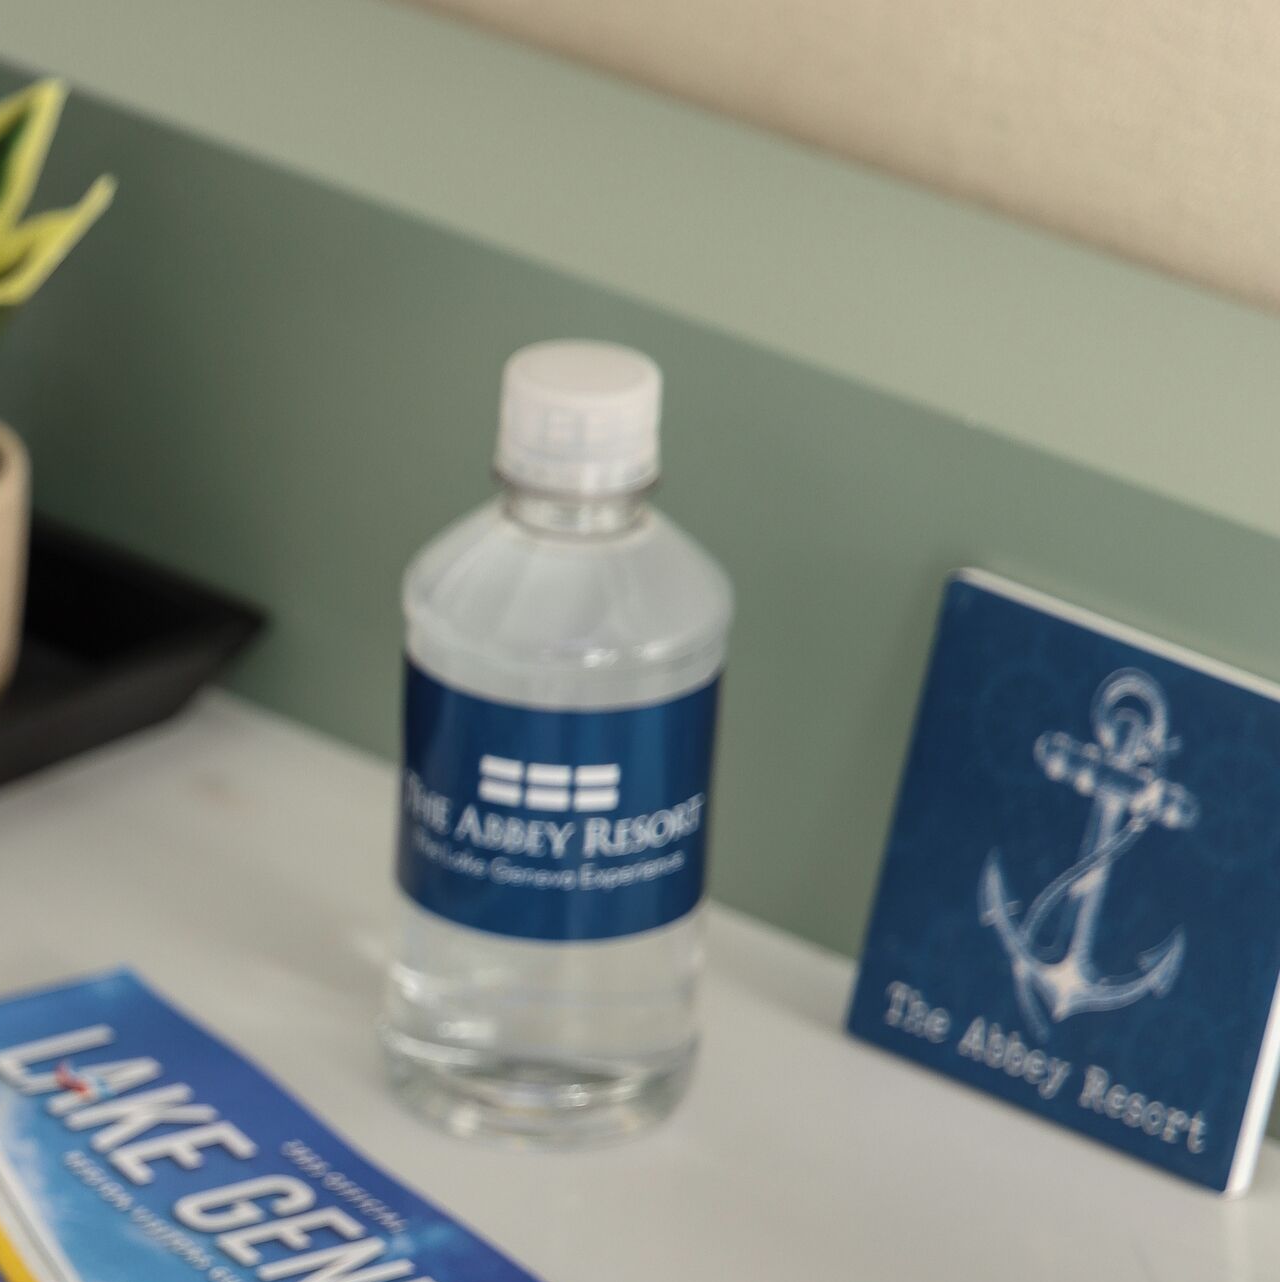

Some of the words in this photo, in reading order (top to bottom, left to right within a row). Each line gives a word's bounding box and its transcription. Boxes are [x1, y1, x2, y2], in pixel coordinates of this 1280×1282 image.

[454, 804, 575, 858] ABBEY
[583, 792, 705, 858] RESORT
[885, 980, 951, 1043] The
[957, 1016, 1072, 1099] Abbey
[1077, 1065, 1207, 1153] Resort
